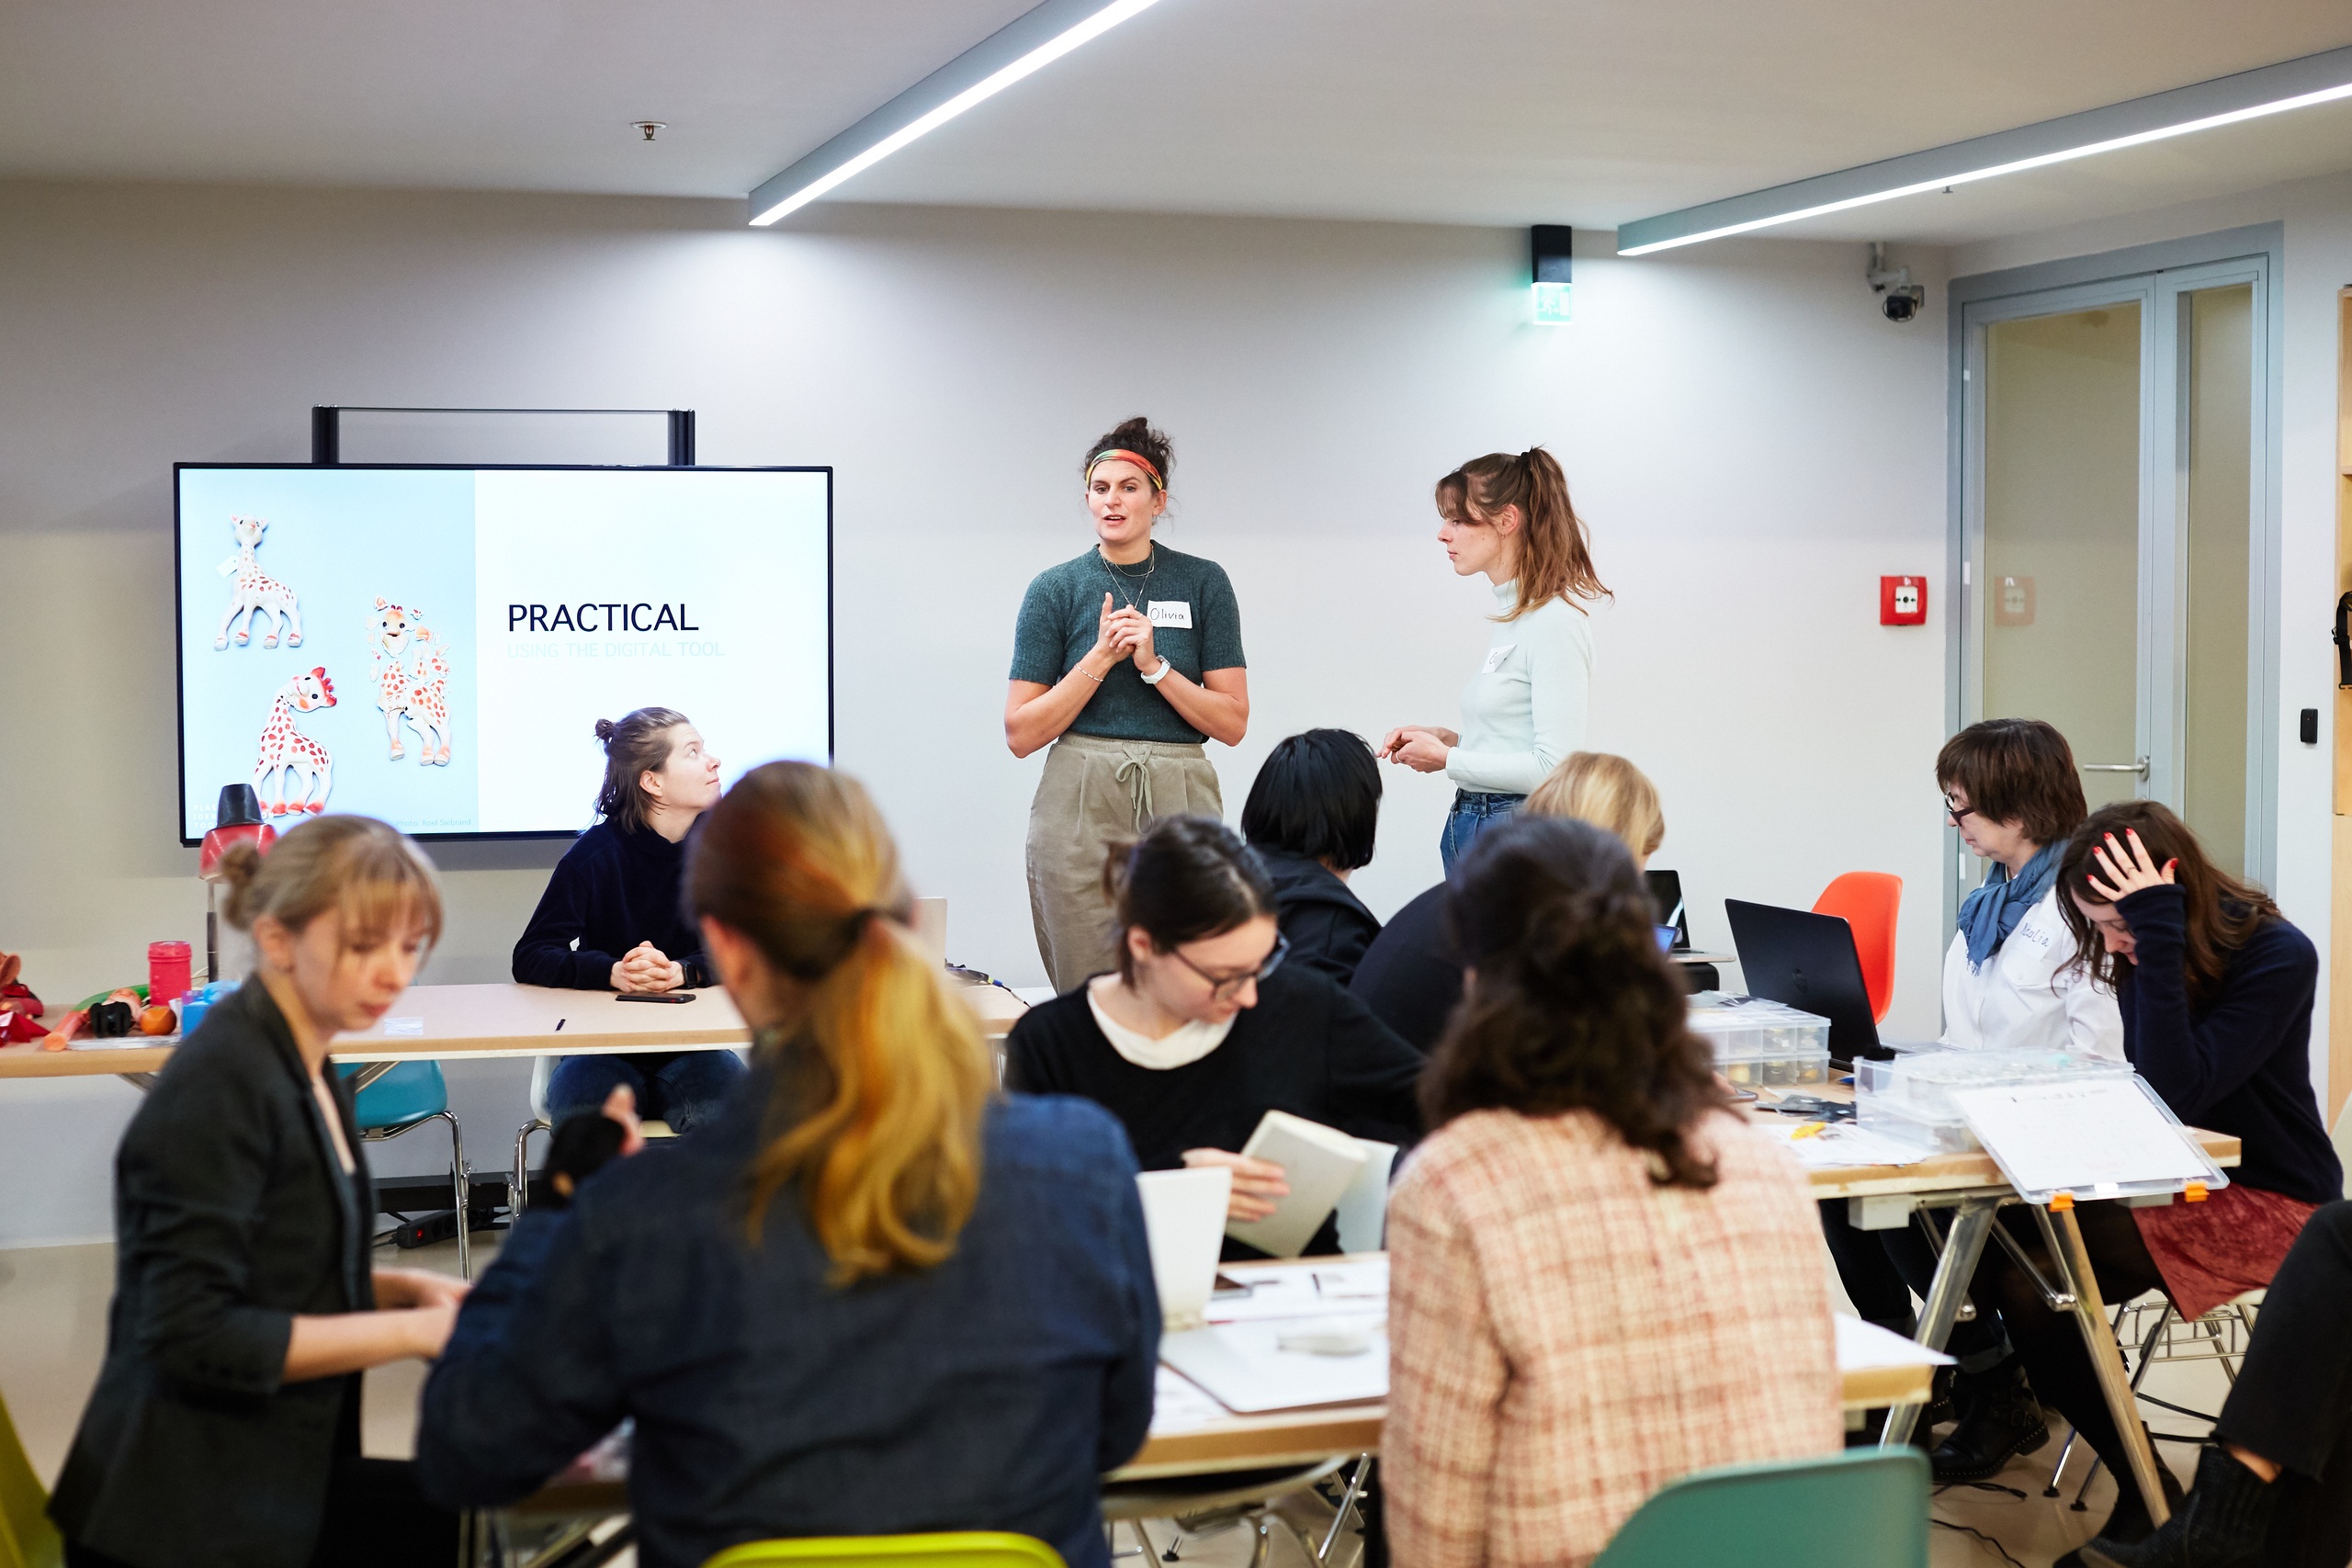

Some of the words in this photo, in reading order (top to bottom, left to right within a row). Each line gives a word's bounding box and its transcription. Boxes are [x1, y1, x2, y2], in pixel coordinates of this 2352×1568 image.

[508, 603, 699, 632] PRACTICAL
[1149, 607, 1185, 621] Olivia
[507, 643, 560, 659] USING
[565, 642, 599, 658] THE
[605, 642, 673, 658] DIGITAL
[677, 641, 726, 657] TOOL
[422, 818, 438, 827] Roel
[439, 818, 471, 827] Siebrand
